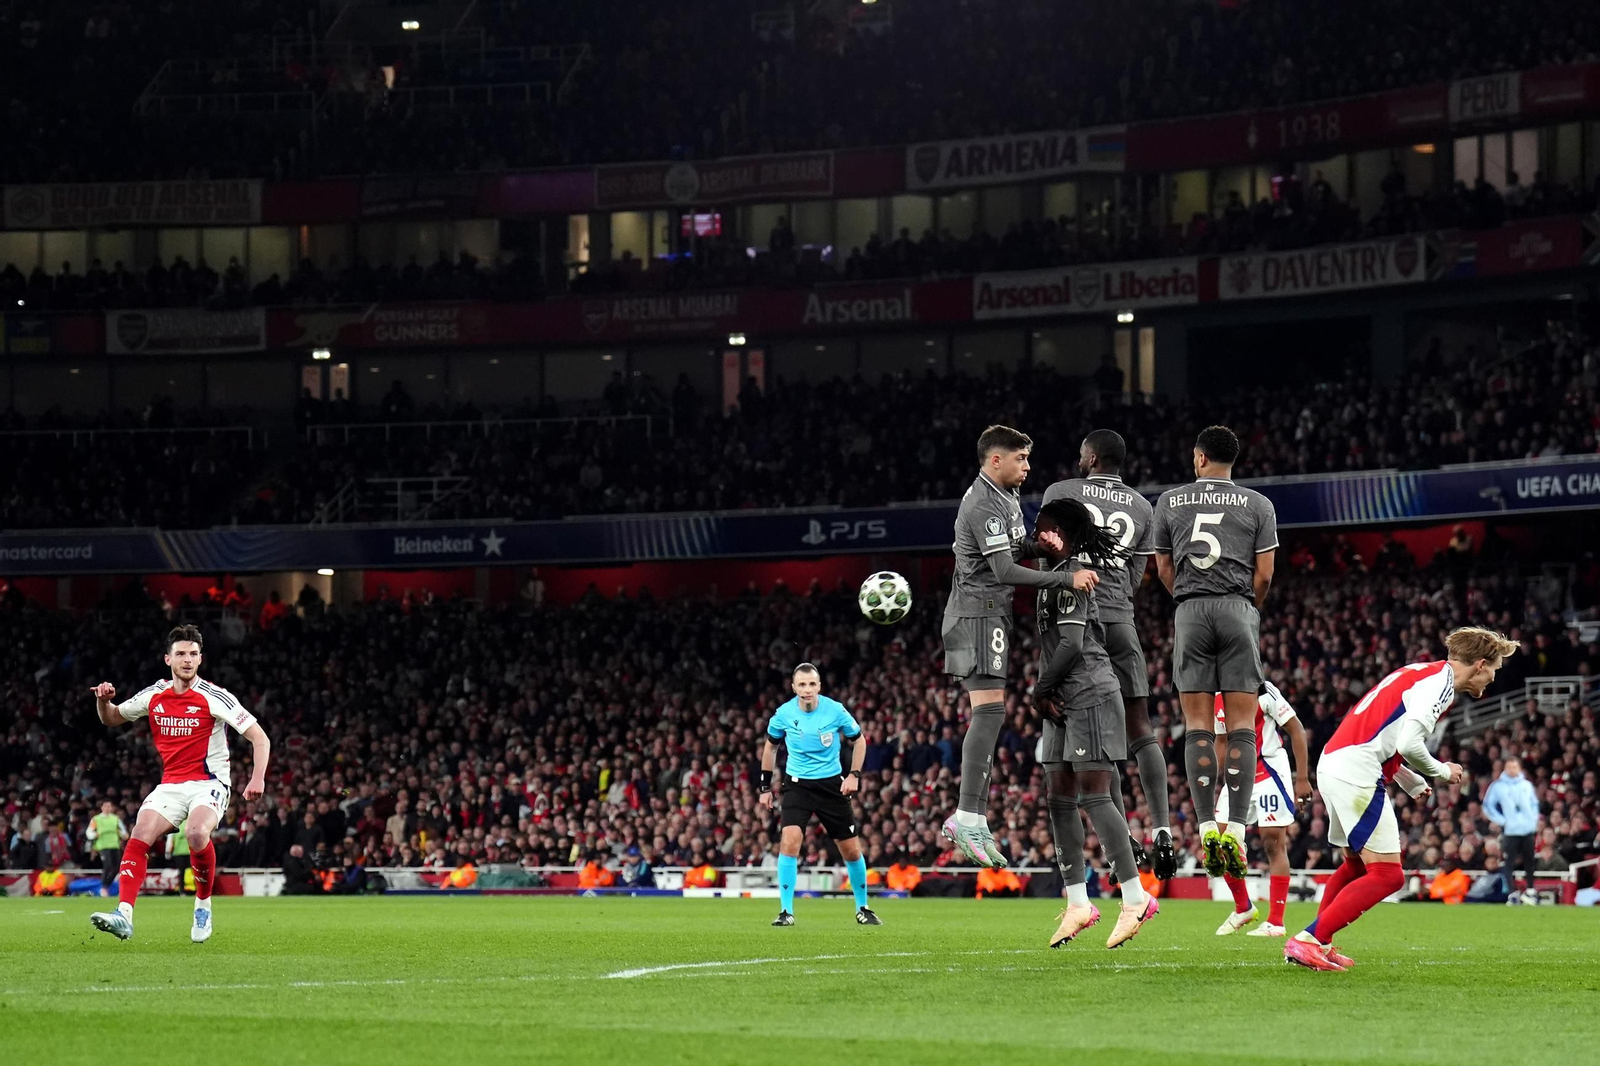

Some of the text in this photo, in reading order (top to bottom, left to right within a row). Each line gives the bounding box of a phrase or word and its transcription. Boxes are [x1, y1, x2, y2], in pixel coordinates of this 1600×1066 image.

[1459, 77, 1510, 116] PERU
[1277, 110, 1341, 148] 1938
[944, 135, 1078, 179] ARMENIA
[157, 181, 250, 205] ARSENAL
[1261, 245, 1391, 292] DAVENTRY
[976, 266, 1197, 311] Arsenal Liberia
[612, 298, 677, 319] ARSENAL
[802, 289, 912, 325] Arsenal
[374, 324, 458, 341] GUNNERS
[1082, 484, 1133, 506] RÜDIGER
[1517, 475, 1564, 499] UEFA
[1169, 492, 1249, 508] BELLINGHAM
[829, 519, 888, 541] PS5
[1185, 512, 1225, 570] 5
[393, 534, 475, 555] Heineken
[1058, 590, 1075, 614] hp
[991, 627, 1005, 654] 8
[154, 714, 200, 727] Emirates
[160, 726, 193, 737] FLY BETTER
[210, 789, 220, 802] 4
[1259, 794, 1279, 813] 49
